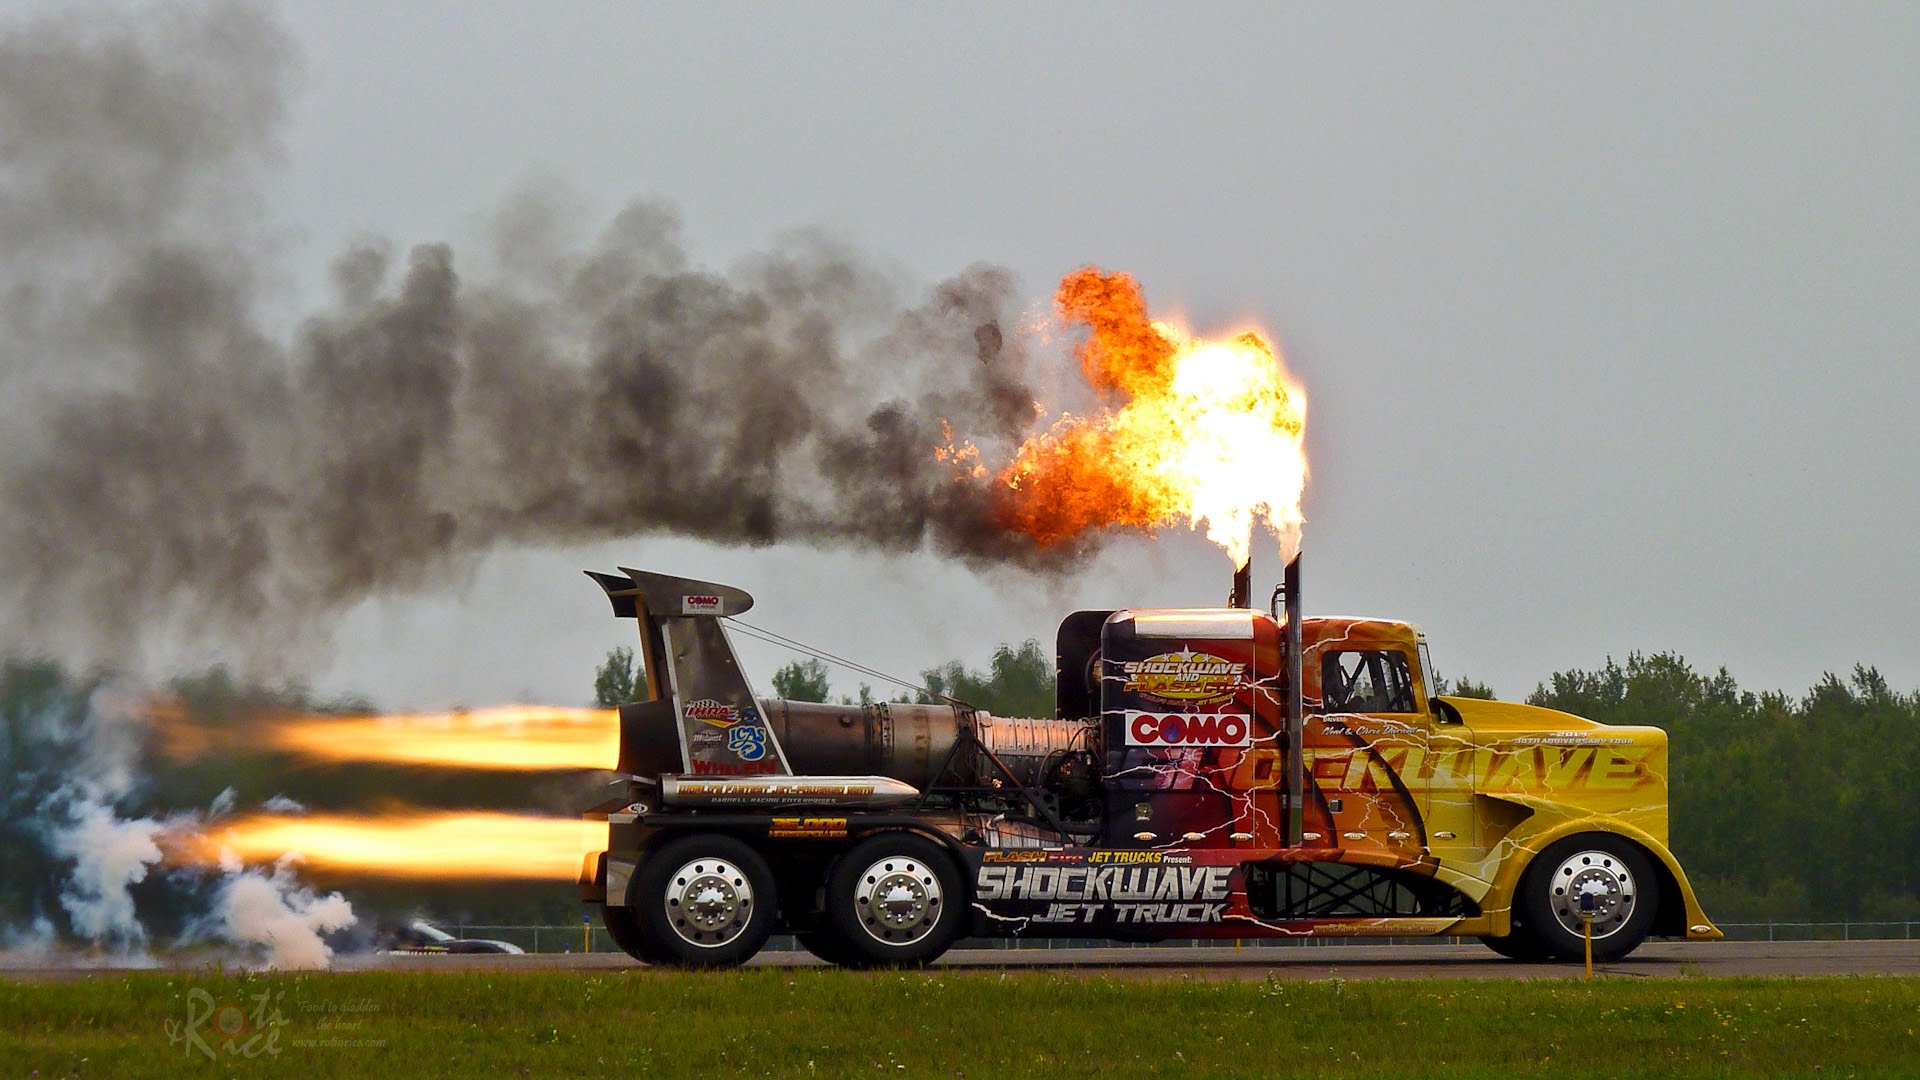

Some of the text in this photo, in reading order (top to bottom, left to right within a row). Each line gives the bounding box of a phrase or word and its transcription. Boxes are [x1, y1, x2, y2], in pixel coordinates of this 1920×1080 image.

[688, 597, 719, 605] COMO
[1124, 662, 1247, 674] SHOCKWAVE
[1174, 674, 1200, 682] AND
[1123, 682, 1203, 693] FLASH
[686, 706, 729, 717] IHRA
[729, 726, 766, 743] ICAS
[1131, 715, 1247, 745] COMO
[983, 851, 1047, 863] FLASH
[1087, 851, 1111, 863] JET
[1112, 851, 1163, 863] TRUCKS
[1163, 855, 1193, 864] Present:
[976, 865, 1234, 901] SHOCKWAVE
[1032, 903, 1227, 924] JET TRUCK
